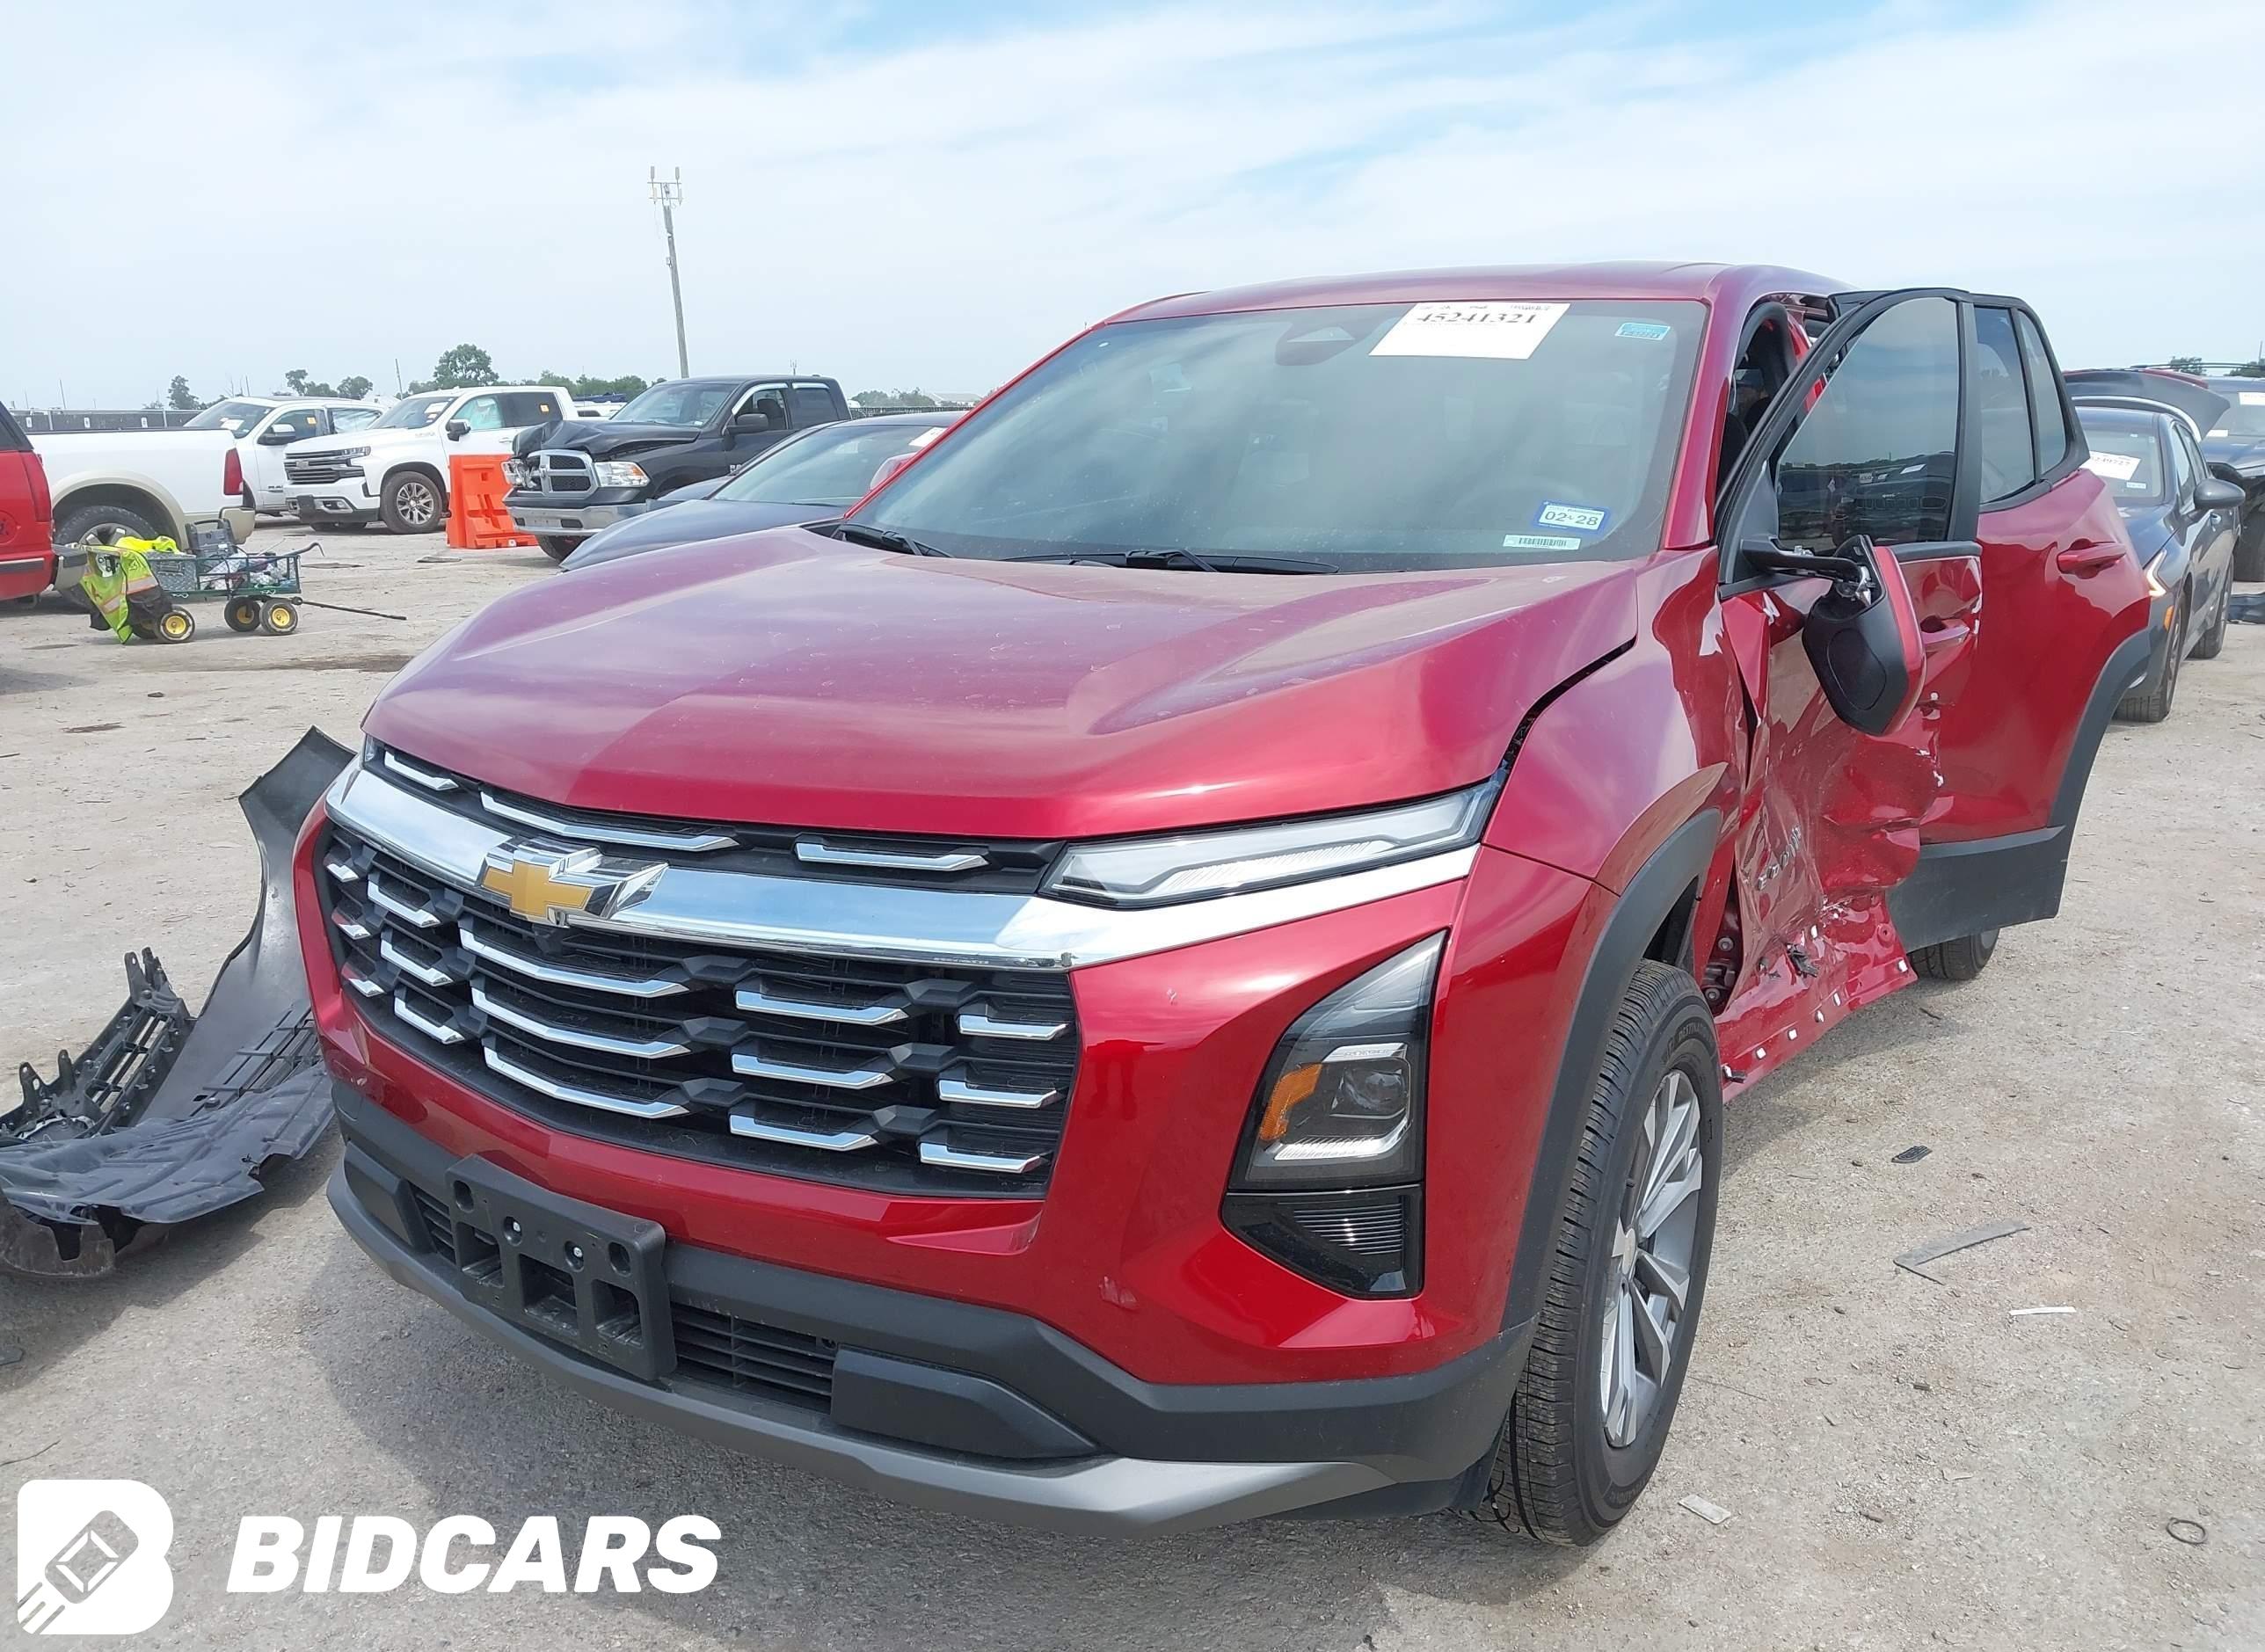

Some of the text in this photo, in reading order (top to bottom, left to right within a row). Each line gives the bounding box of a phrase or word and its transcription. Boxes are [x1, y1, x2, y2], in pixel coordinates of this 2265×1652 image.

[1417, 311, 1538, 324] 45241321
[1544, 511, 1568, 522] 02
[1575, 514, 1599, 527] 28
